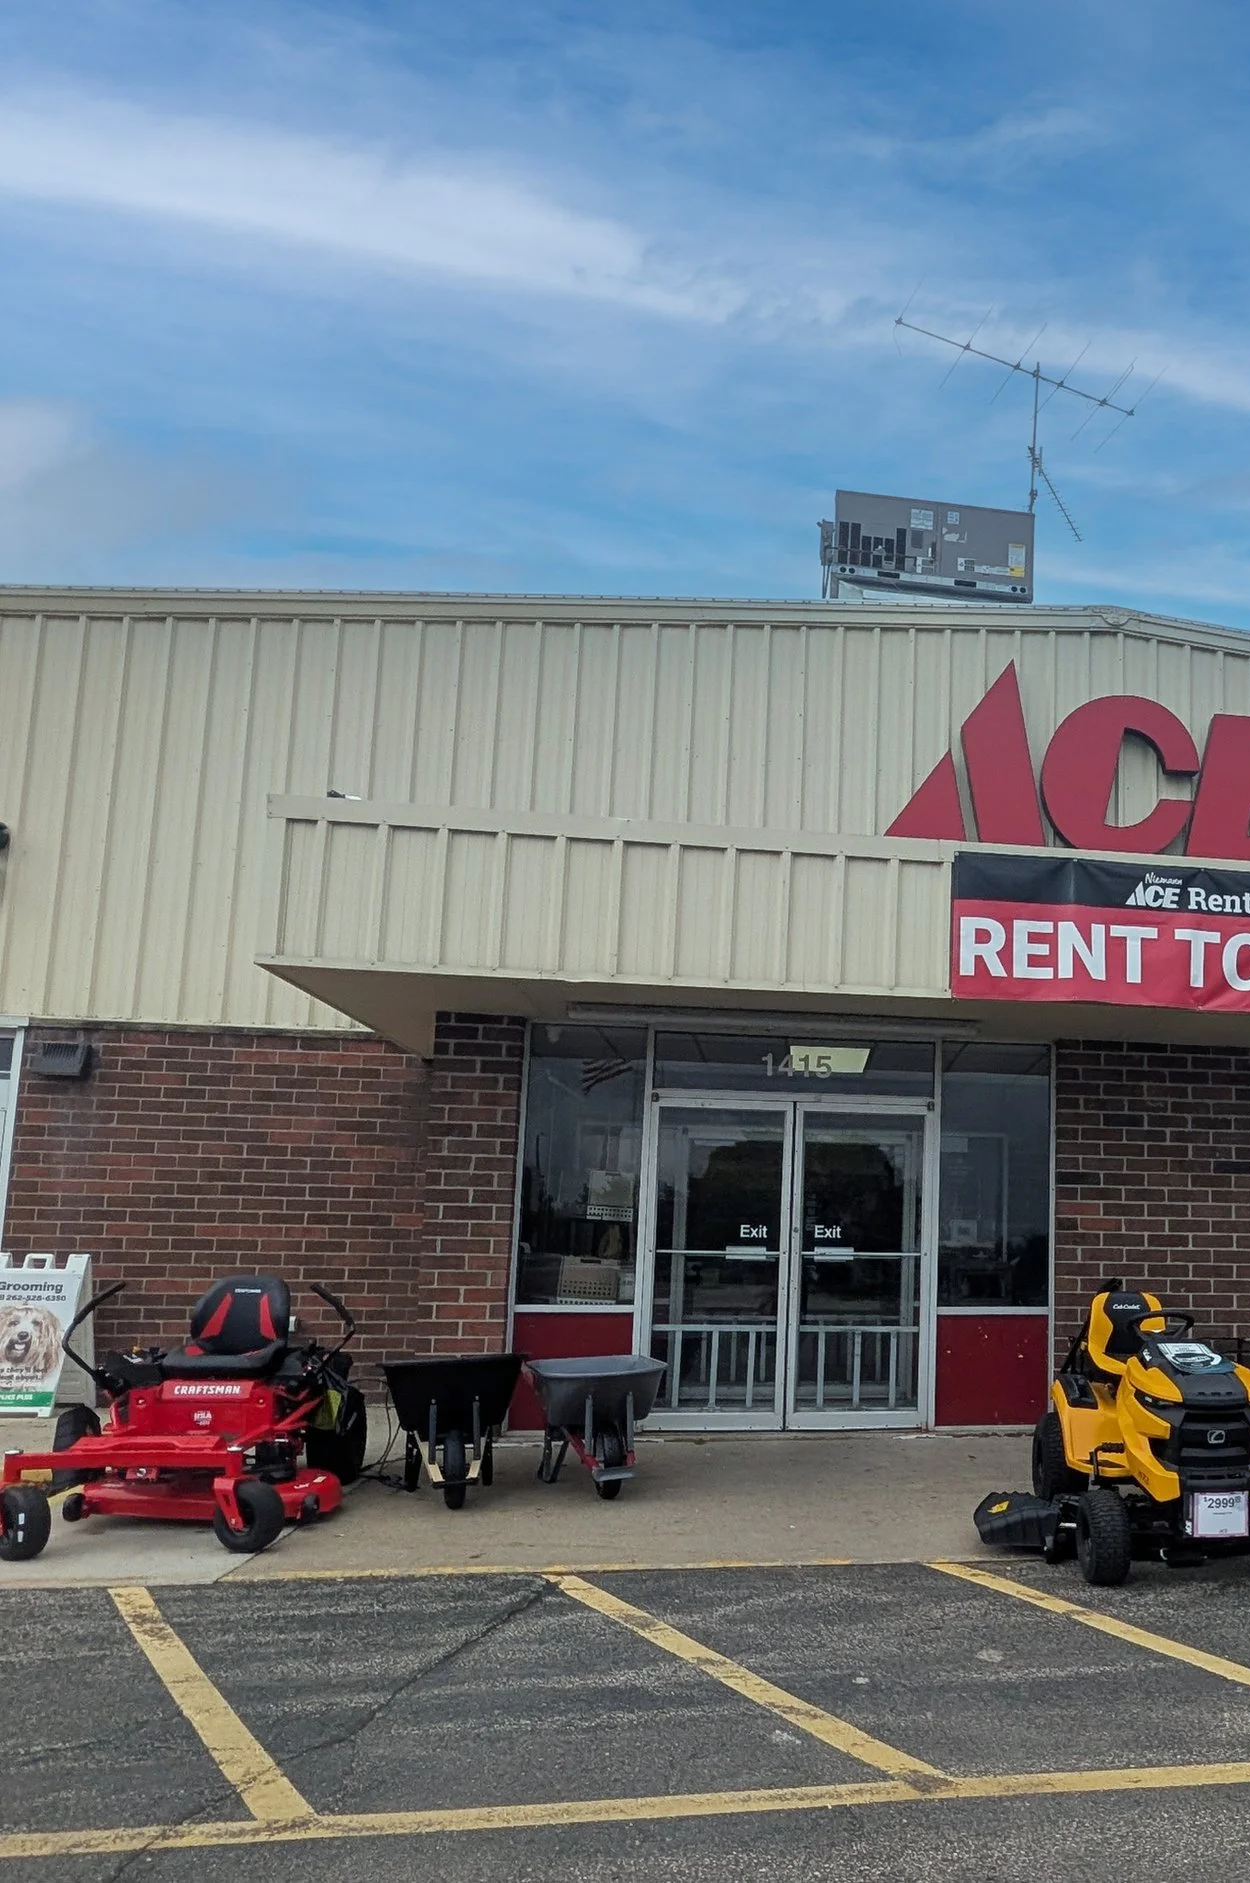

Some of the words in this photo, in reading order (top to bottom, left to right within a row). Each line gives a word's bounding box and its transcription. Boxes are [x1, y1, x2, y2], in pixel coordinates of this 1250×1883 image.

[1144, 872, 1183, 885] Niemann
[1125, 881, 1181, 909] ACE
[958, 916, 1159, 984] RENT
[761, 1052, 832, 1079] 1415
[740, 1224, 768, 1239] Exit
[814, 1224, 842, 1239] Exit
[0, 1281, 63, 1294] Grooming
[174, 1385, 241, 1395] CRAFTSMAN
